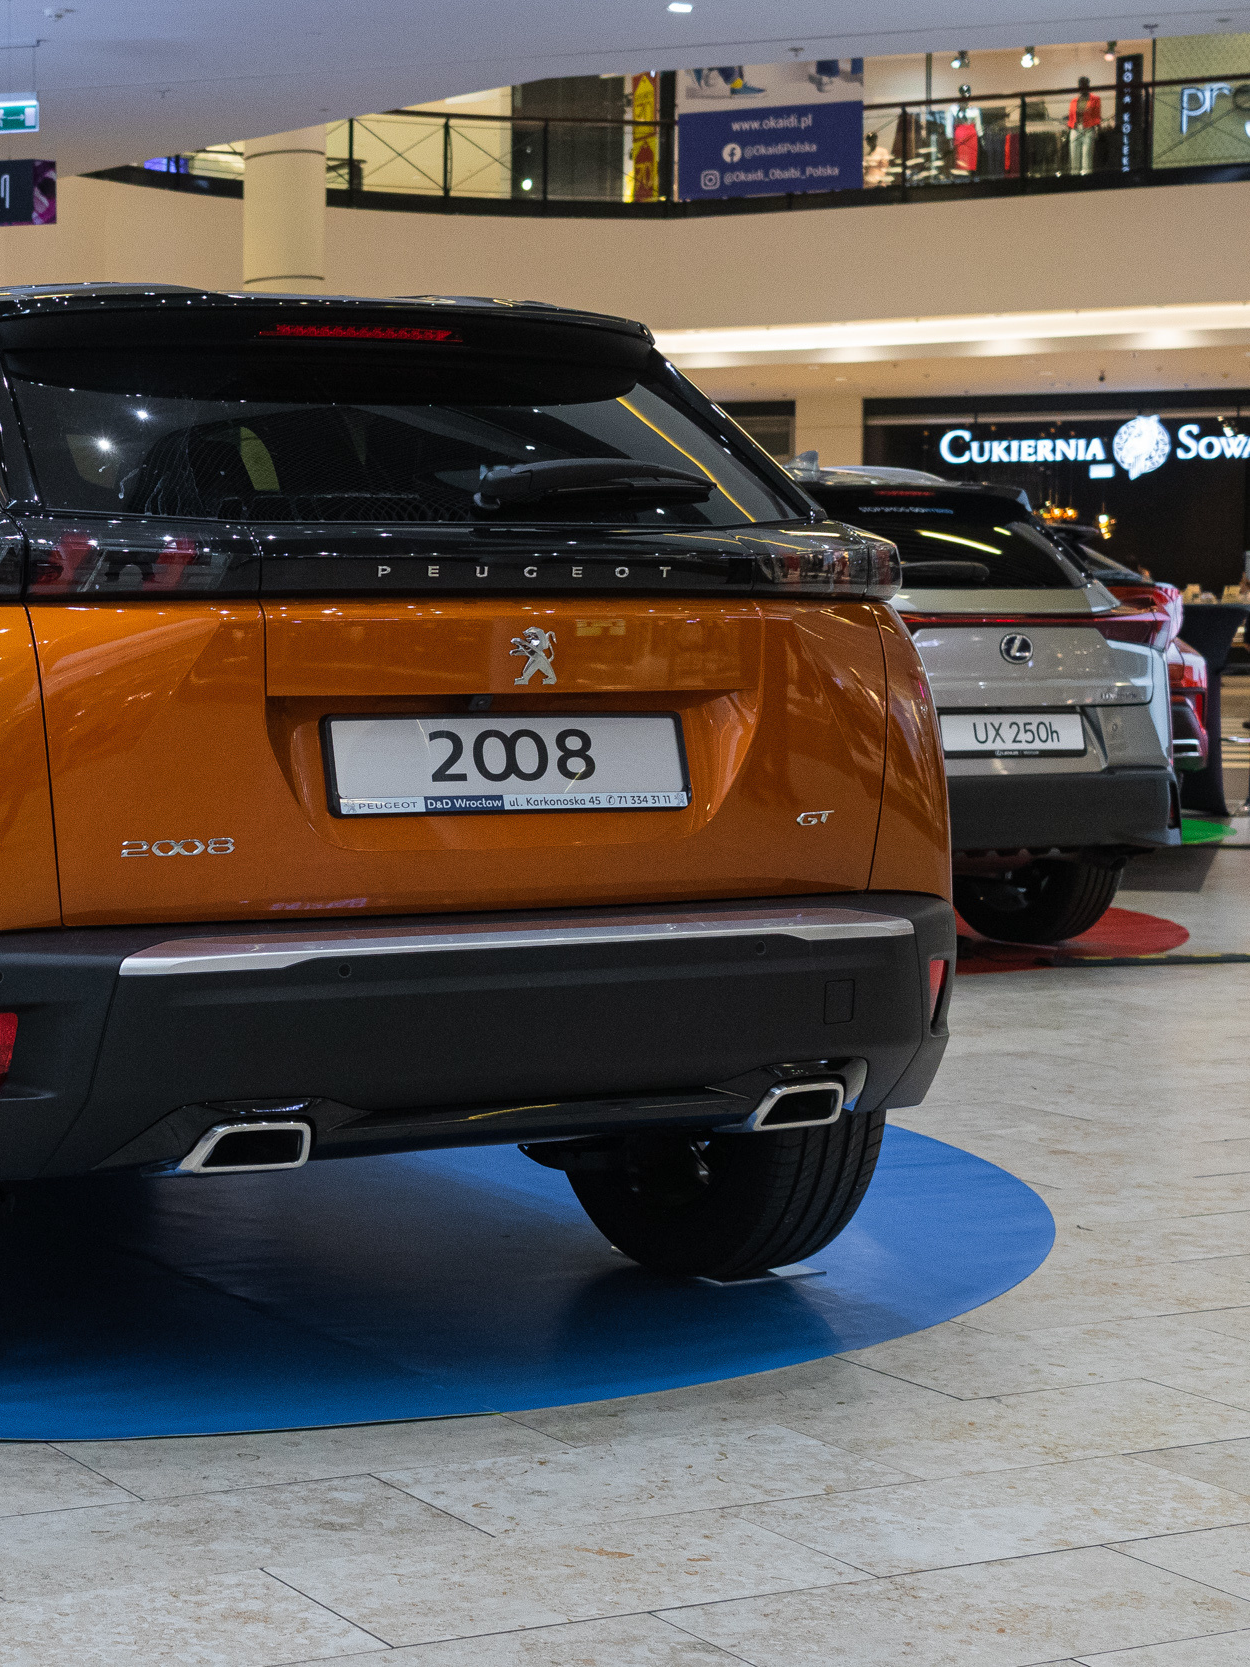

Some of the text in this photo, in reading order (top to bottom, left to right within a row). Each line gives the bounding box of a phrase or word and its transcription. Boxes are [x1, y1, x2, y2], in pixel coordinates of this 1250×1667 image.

[731, 114, 812, 132] www.okaidi.pl
[744, 143, 817, 159] @OkaidiPolska
[939, 429, 1106, 464] CUKIERNIA
[377, 565, 672, 578] PEUGEOT
[973, 721, 1060, 744] UX 250h
[428, 728, 596, 783] 2008
[358, 801, 418, 810] PEUGEOT
[427, 799, 452, 809] D&D
[509, 797, 523, 807] ul.
[526, 796, 586, 806] Karkonoska
[588, 795, 601, 805] 45
[617, 795, 628, 805] 71
[630, 795, 648, 805] 334
[651, 794, 661, 804] 31
[663, 794, 671, 804] 11
[796, 809, 835, 826] GT
[120, 837, 236, 858] 2008
